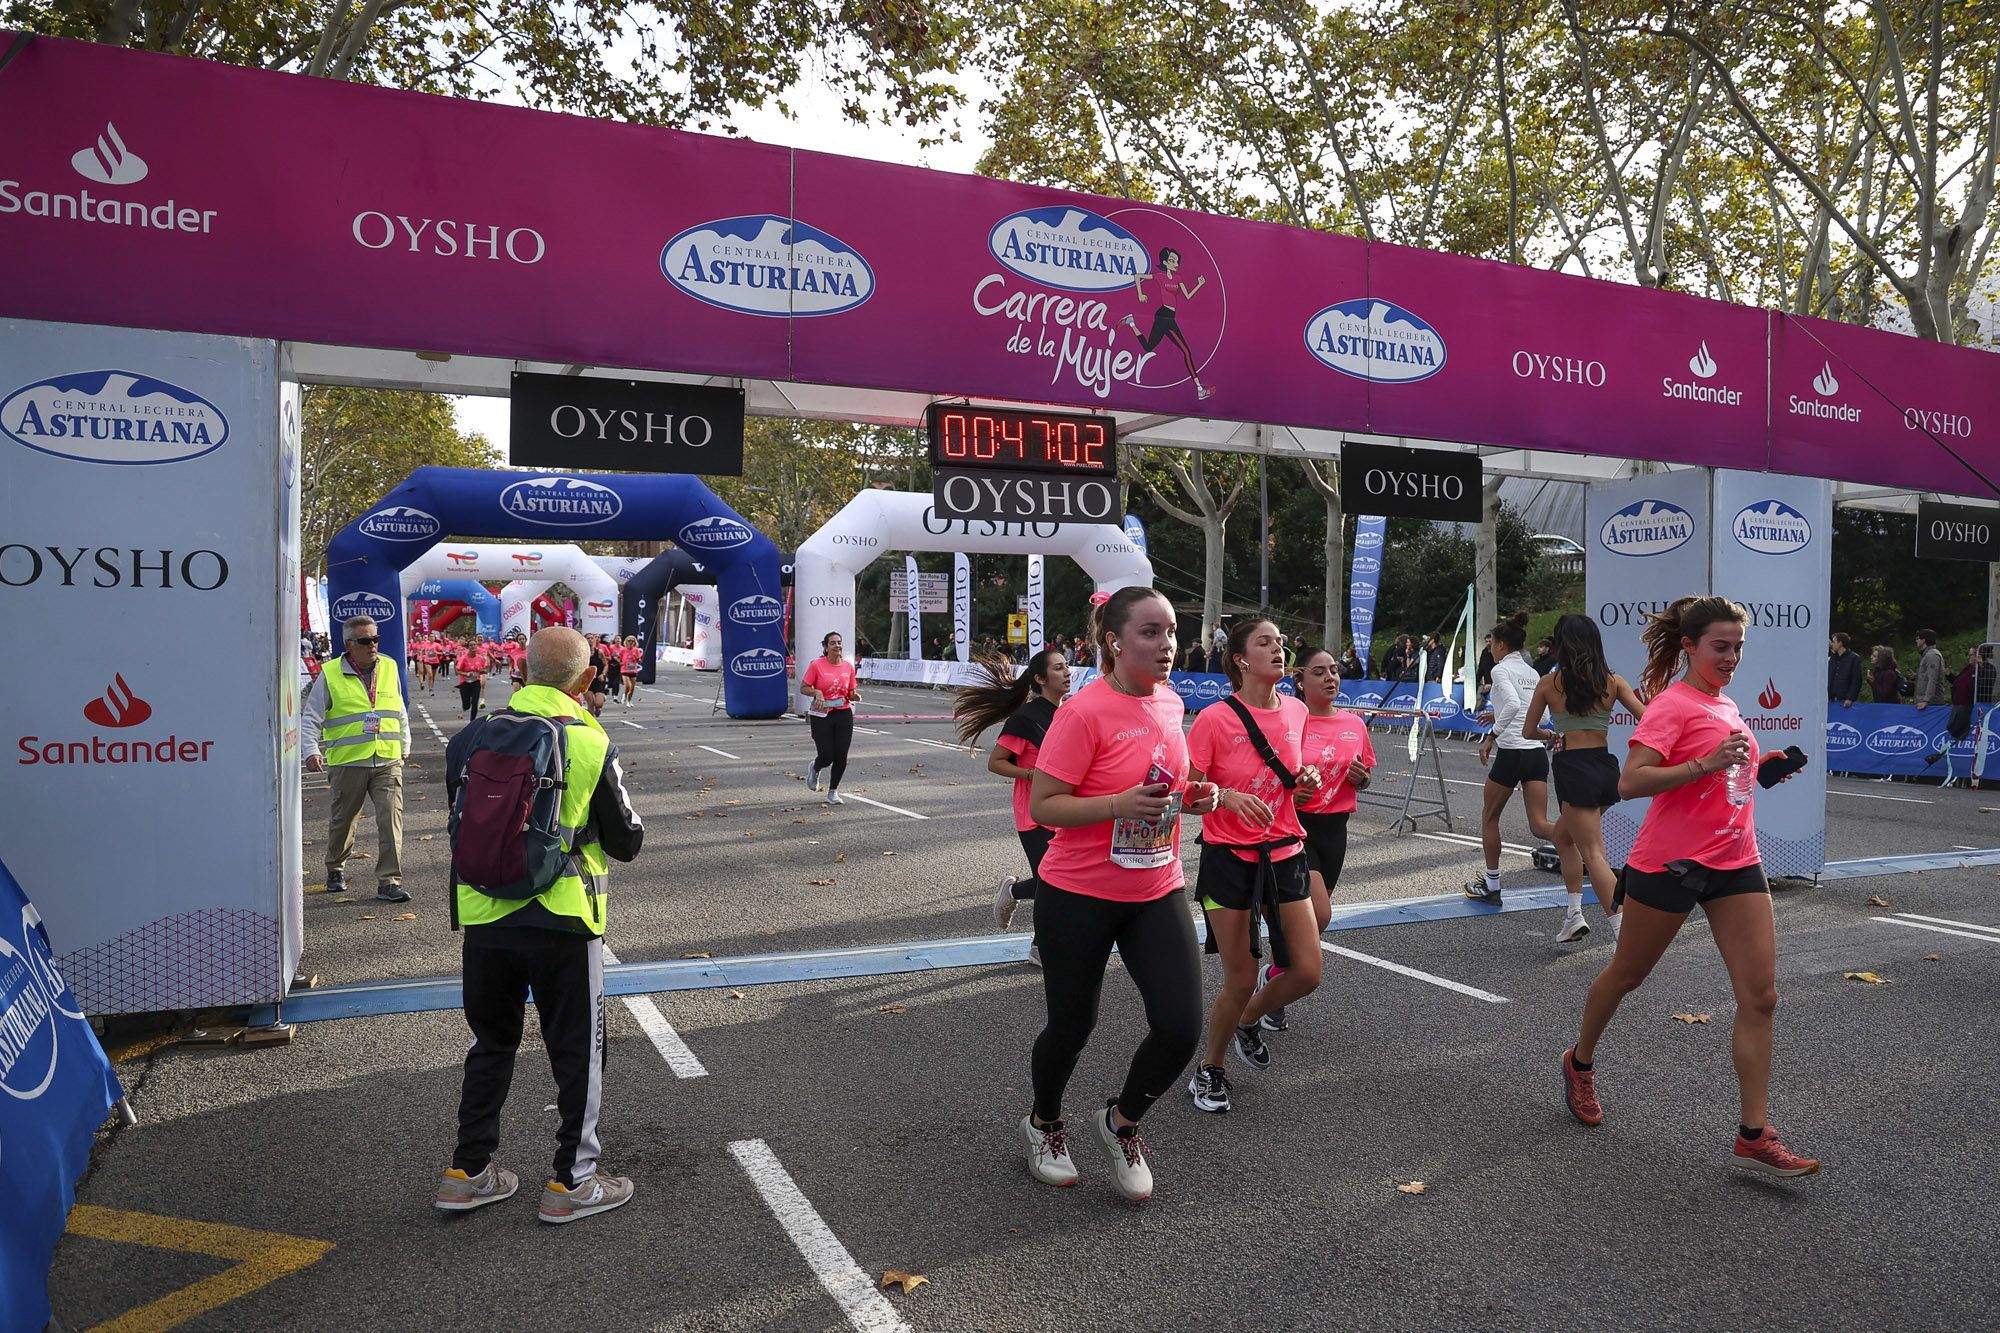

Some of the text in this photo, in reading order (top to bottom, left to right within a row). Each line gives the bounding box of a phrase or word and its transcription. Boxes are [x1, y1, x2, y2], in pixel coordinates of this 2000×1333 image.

[0, 180, 217, 234] Santander
[352, 211, 547, 264] OYSHO
[1027, 229, 1134, 252] CENTRAL LECHERA
[712, 245, 853, 268] CENTRAL LECHERA
[1002, 228, 1138, 276] ASTURIANA
[678, 244, 859, 297] ASTURIANA
[973, 274, 1107, 331] Carrera
[1006, 324, 1056, 358] de la
[1316, 321, 1436, 367] ASTURIANA
[1339, 322, 1432, 343] CENTRAL LECHERA
[1051, 327, 1157, 398] Mujer
[1512, 350, 1606, 387] OYSHO
[1663, 377, 1743, 405] Santander
[53, 400, 205, 418] CENTRAL LECHERA
[1789, 395, 1861, 422] Santander
[15, 400, 213, 445] ASTURIANA
[551, 405, 712, 447] OYSHO
[1904, 407, 1972, 438] OYSHO
[944, 415, 1104, 465] 00:47:02
[528, 489, 567, 497] CENTRAL
[943, 475, 1112, 518] OYSHO
[1364, 469, 1464, 500] OYSHO
[510, 490, 614, 515] ASTURIANA
[364, 519, 433, 533] ASTURIANA
[686, 530, 748, 541] ASTURIANA
[1606, 523, 1688, 546] ASTURIANA
[1621, 518, 1650, 527] CENTRAL
[1738, 518, 1806, 543] ASTURIANA
[1931, 519, 1990, 545] OYSHO
[832, 534, 878, 547] OYSHO
[1096, 544, 1134, 553] OYSHO
[0, 544, 230, 591] OYSHO
[335, 604, 392, 618] ASTURIANA
[810, 596, 851, 608] OYSHO
[1600, 601, 1670, 627] OYSH
[1734, 601, 1811, 629] YSHO
[1117, 726, 1150, 741] OYSHO
[1740, 714, 1802, 731] antander
[18, 735, 215, 765] Santander
[1827, 736, 1857, 746] URIANA
[1870, 736, 1922, 748] ASTURIANA
